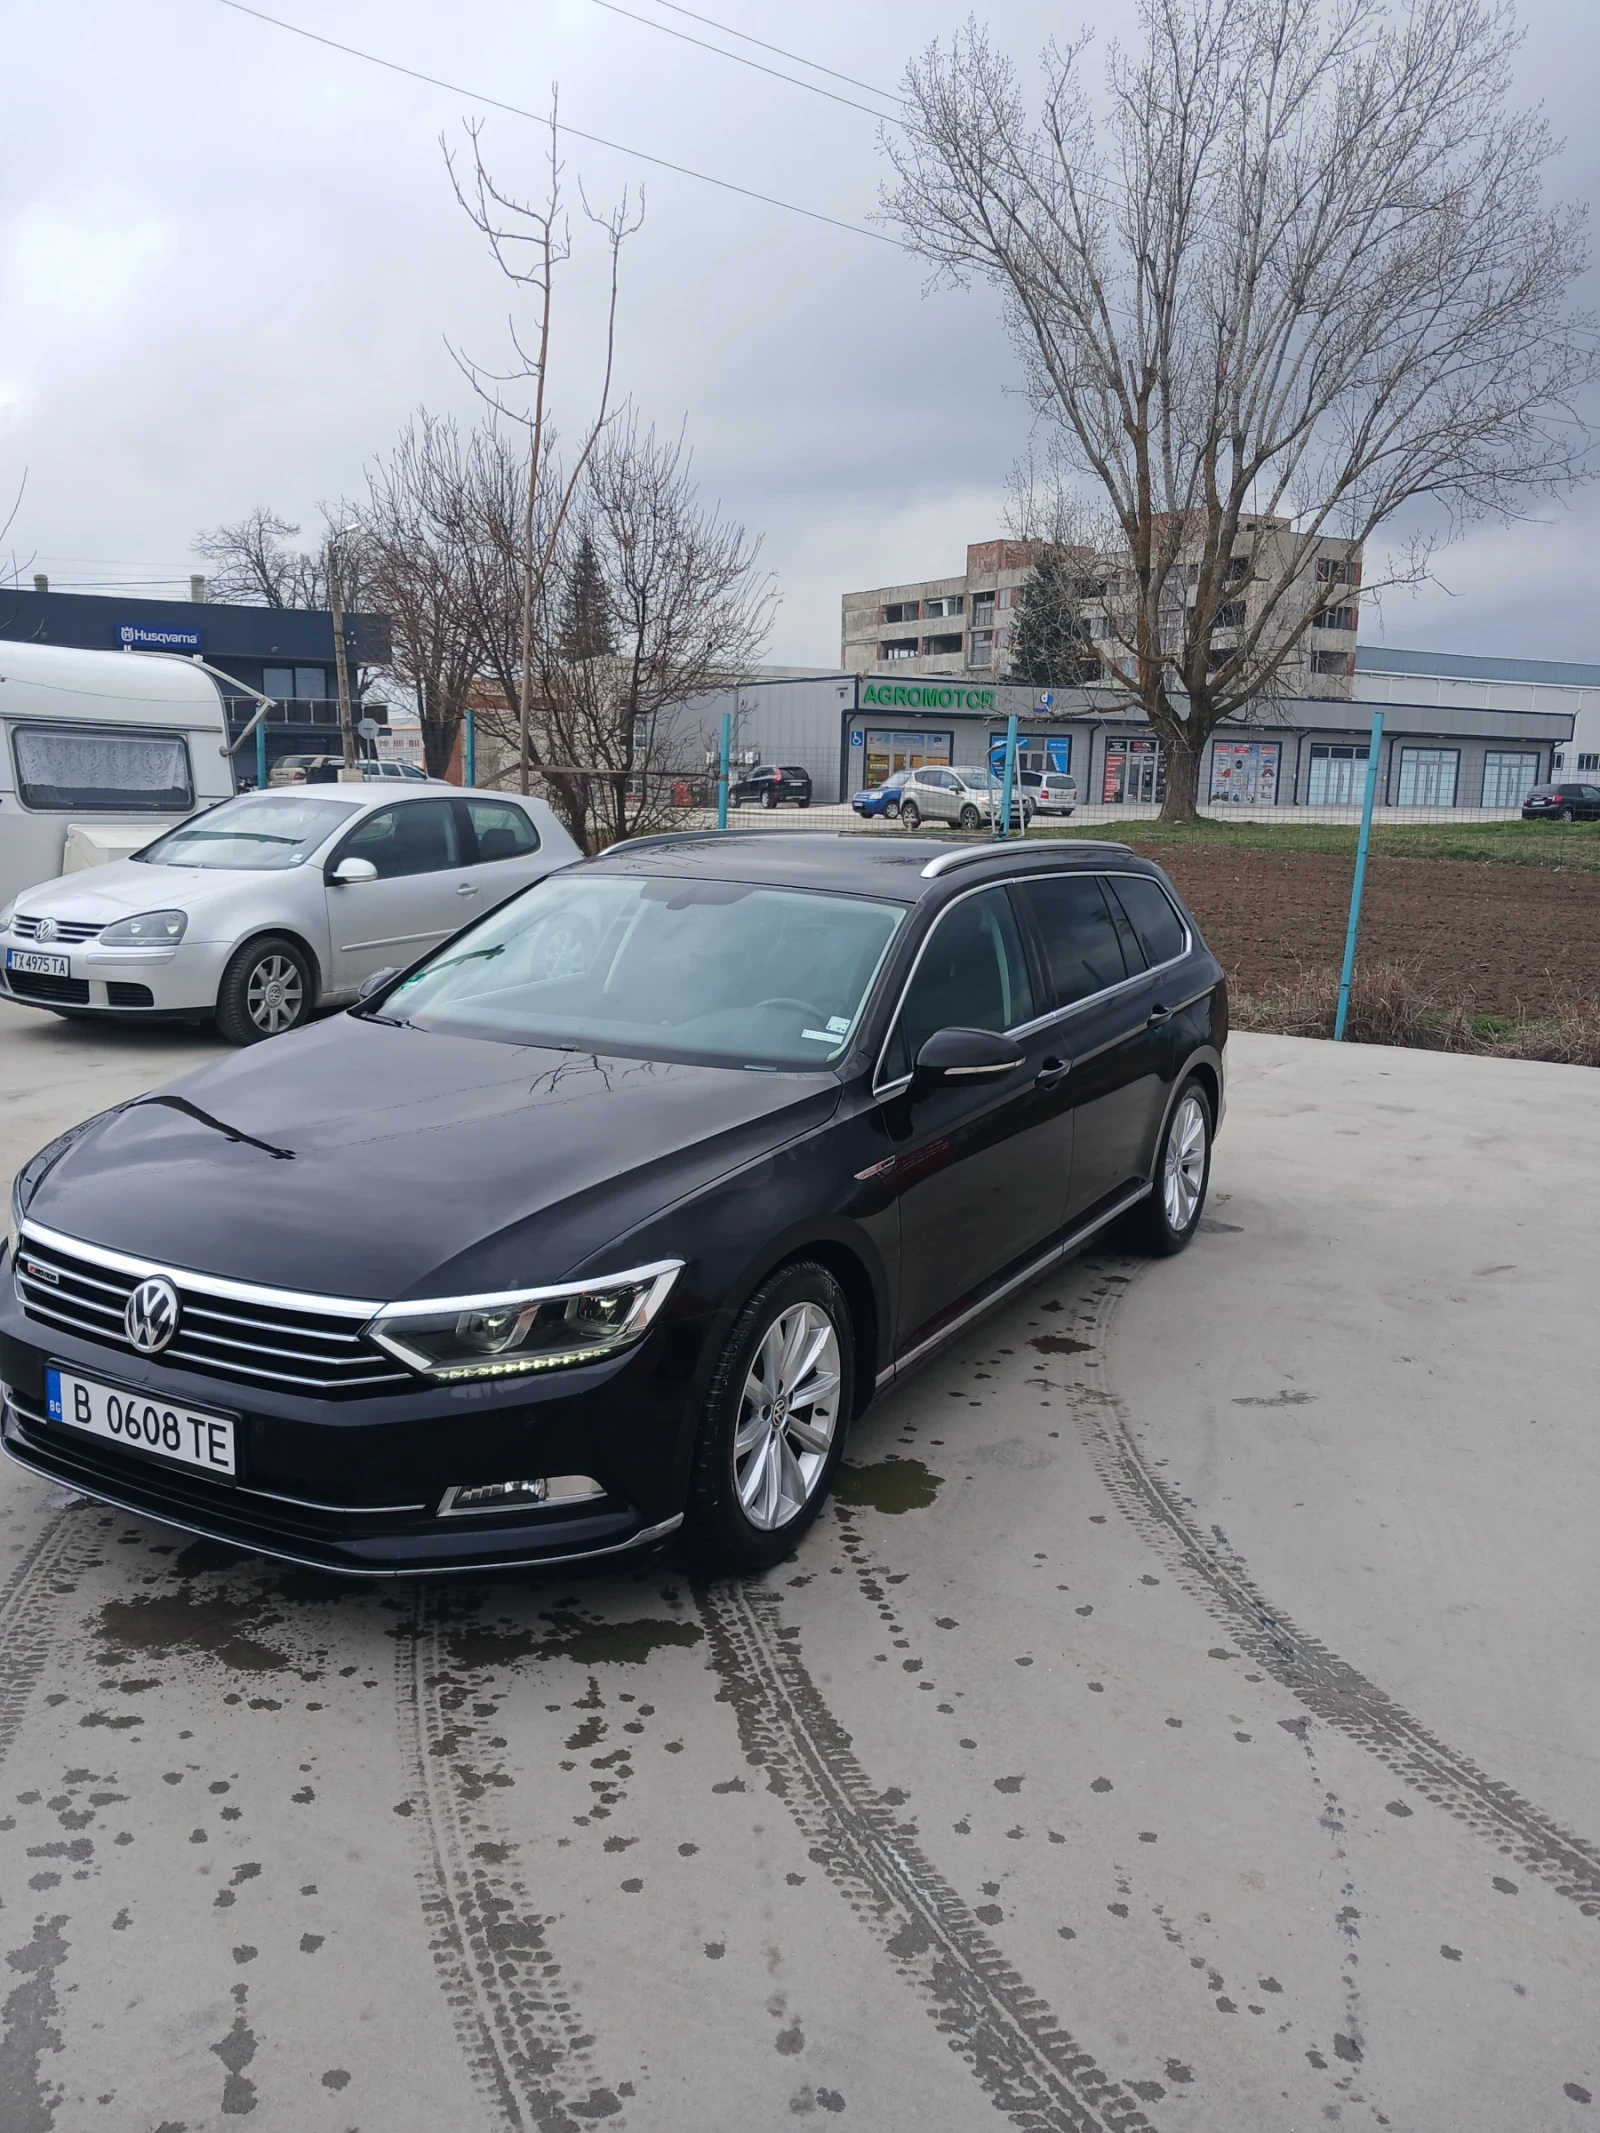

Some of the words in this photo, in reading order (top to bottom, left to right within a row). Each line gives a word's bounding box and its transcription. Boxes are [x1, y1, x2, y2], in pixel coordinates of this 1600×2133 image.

[134, 629, 198, 644] Husqvarna
[863, 685, 995, 709] AGROMOTOR
[13, 953, 25, 969] TX
[26, 955, 50, 972] 4975
[52, 958, 66, 975] TA
[50, 1399, 62, 1414] BG
[74, 1383, 92, 1425] B
[107, 1395, 181, 1451] 0608
[186, 1416, 229, 1467] TE
